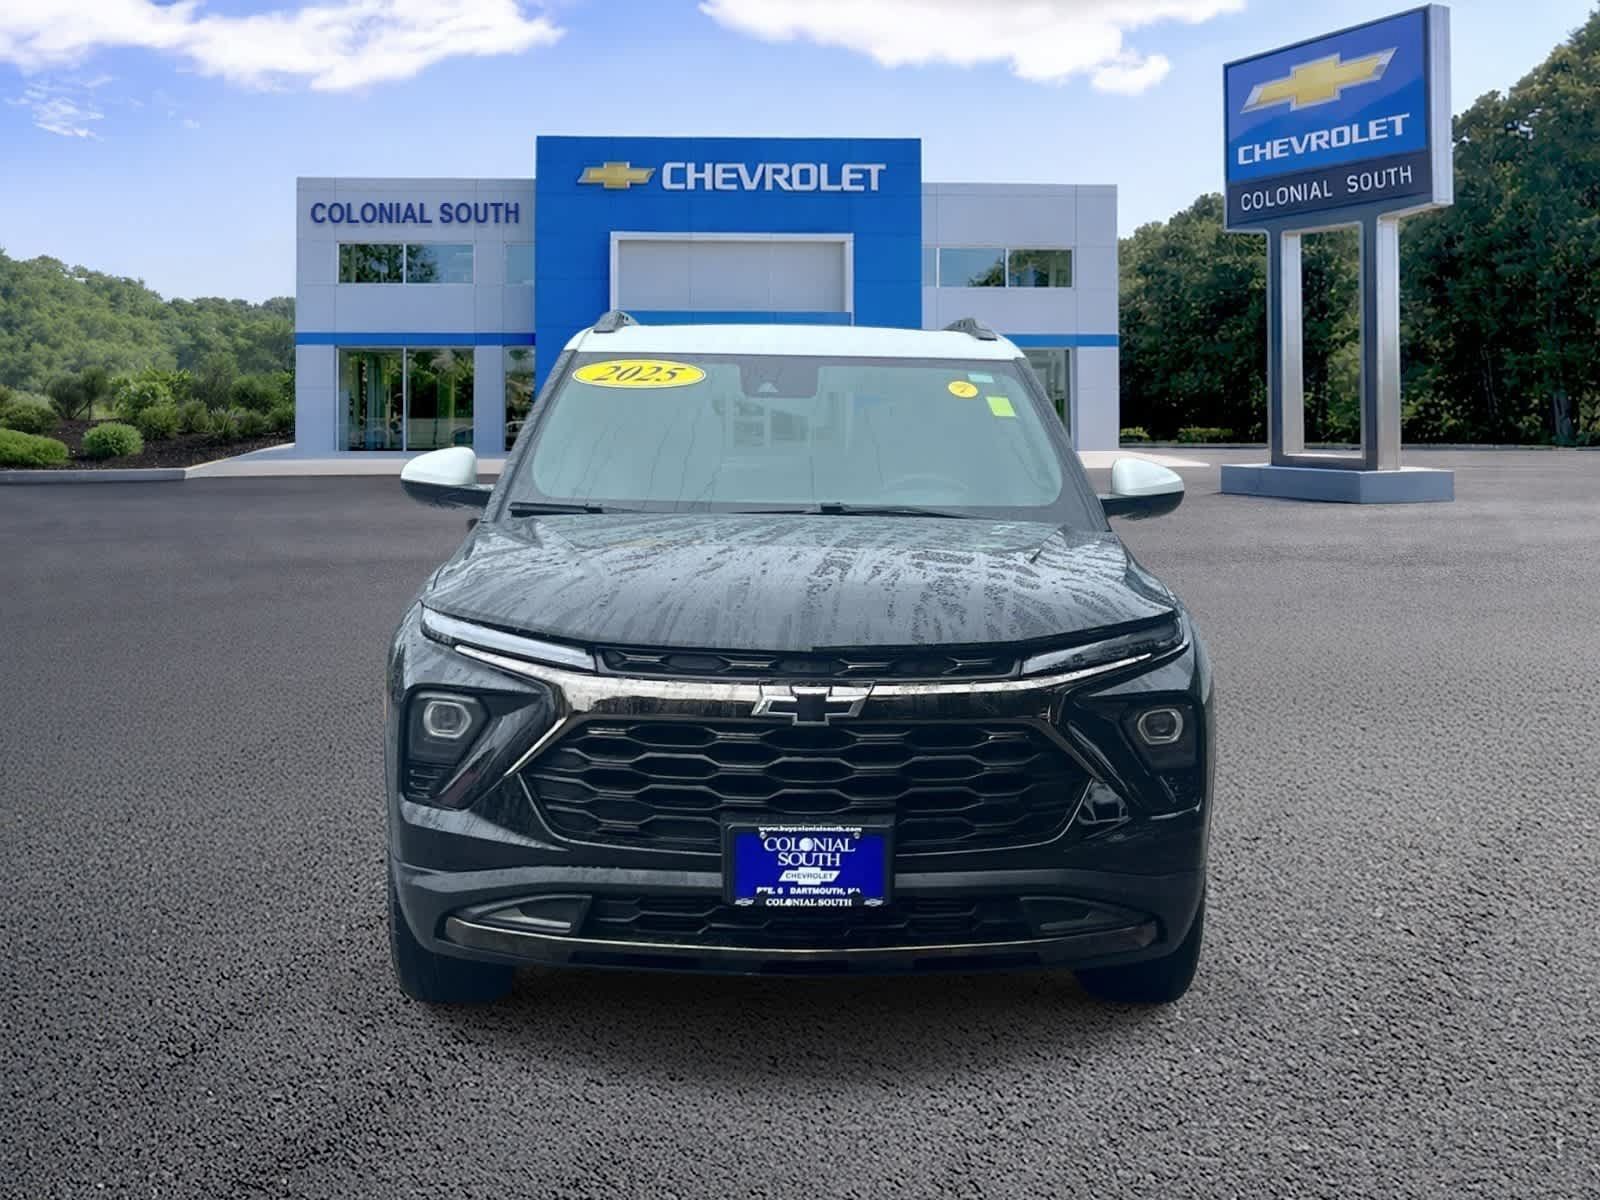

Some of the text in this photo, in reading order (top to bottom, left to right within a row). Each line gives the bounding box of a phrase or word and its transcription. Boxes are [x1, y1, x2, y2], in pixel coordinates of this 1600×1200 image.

[1237, 112, 1411, 166] CHEVROLET
[662, 161, 887, 192] CHEVROLET
[1240, 165, 1413, 212] COLONIAL SOUTH
[310, 202, 520, 225] COLONIAL SOUTH
[592, 365, 686, 382] 2025
[763, 837, 856, 852] COLONIAL
[777, 852, 841, 867] SOUTH
[785, 872, 834, 880] CHEVROLET
[789, 886, 847, 896] DARTMOUTH,
[765, 898, 853, 907] COLONIAL SOUTH
